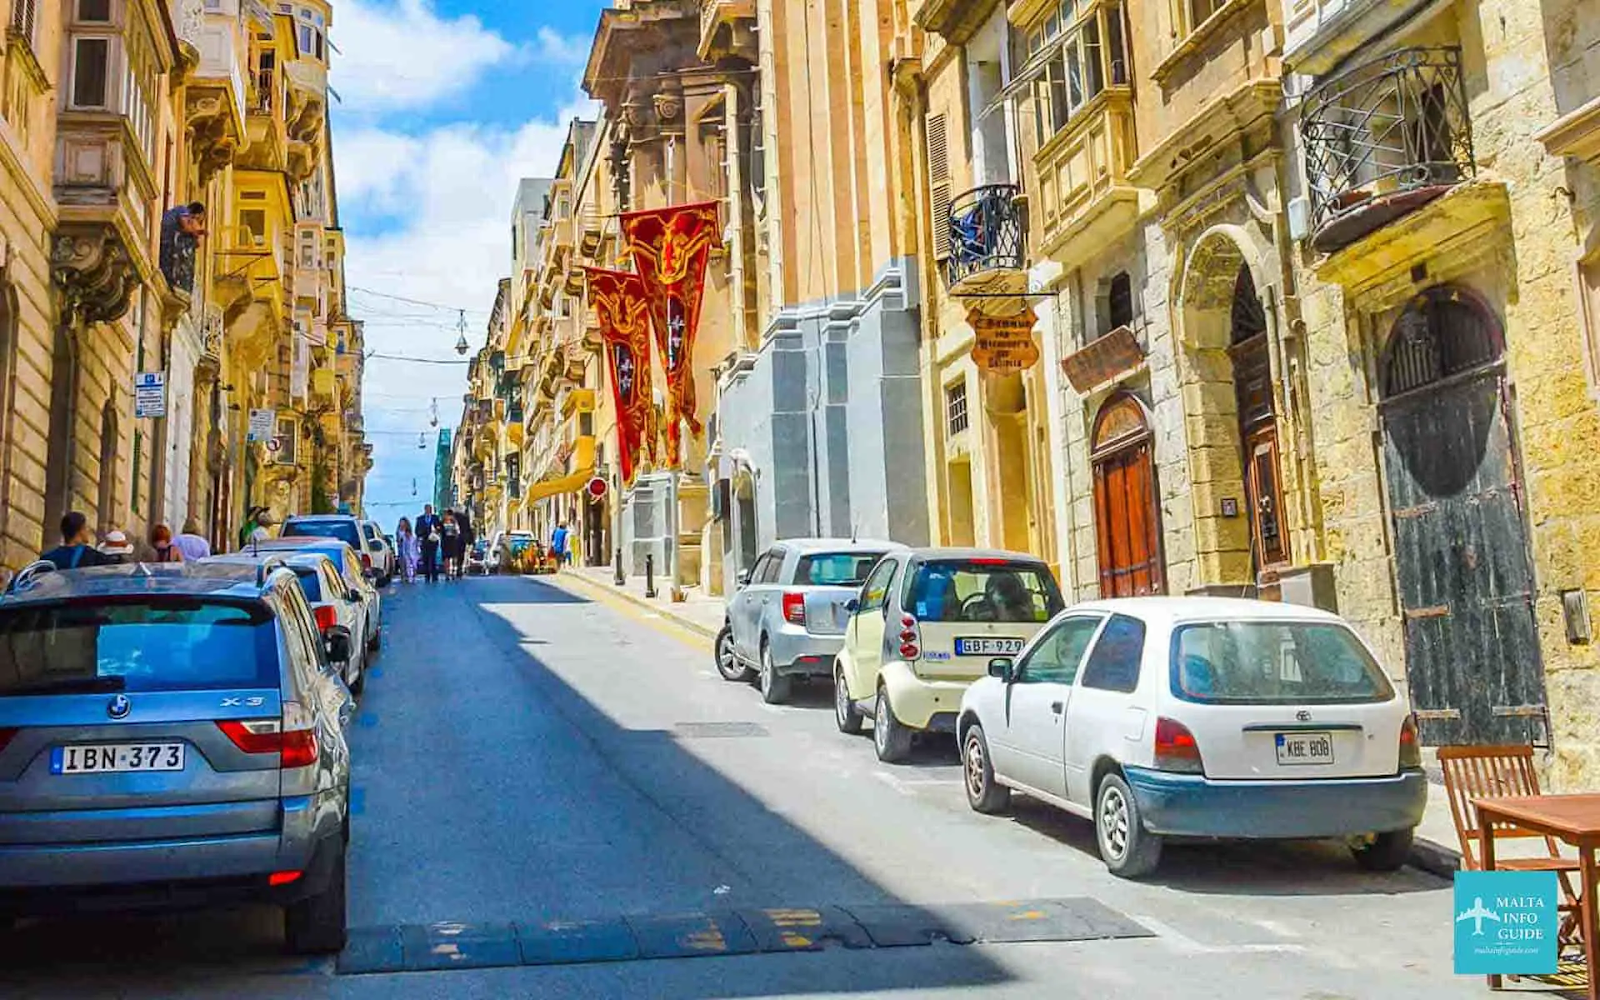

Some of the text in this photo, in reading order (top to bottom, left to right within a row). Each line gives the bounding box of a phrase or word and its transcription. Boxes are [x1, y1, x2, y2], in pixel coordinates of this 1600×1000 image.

[963, 640, 1021, 652] GBF 929
[219, 696, 265, 707] X3
[1286, 739, 1308, 757] KBE
[66, 745, 181, 771] IBN 373
